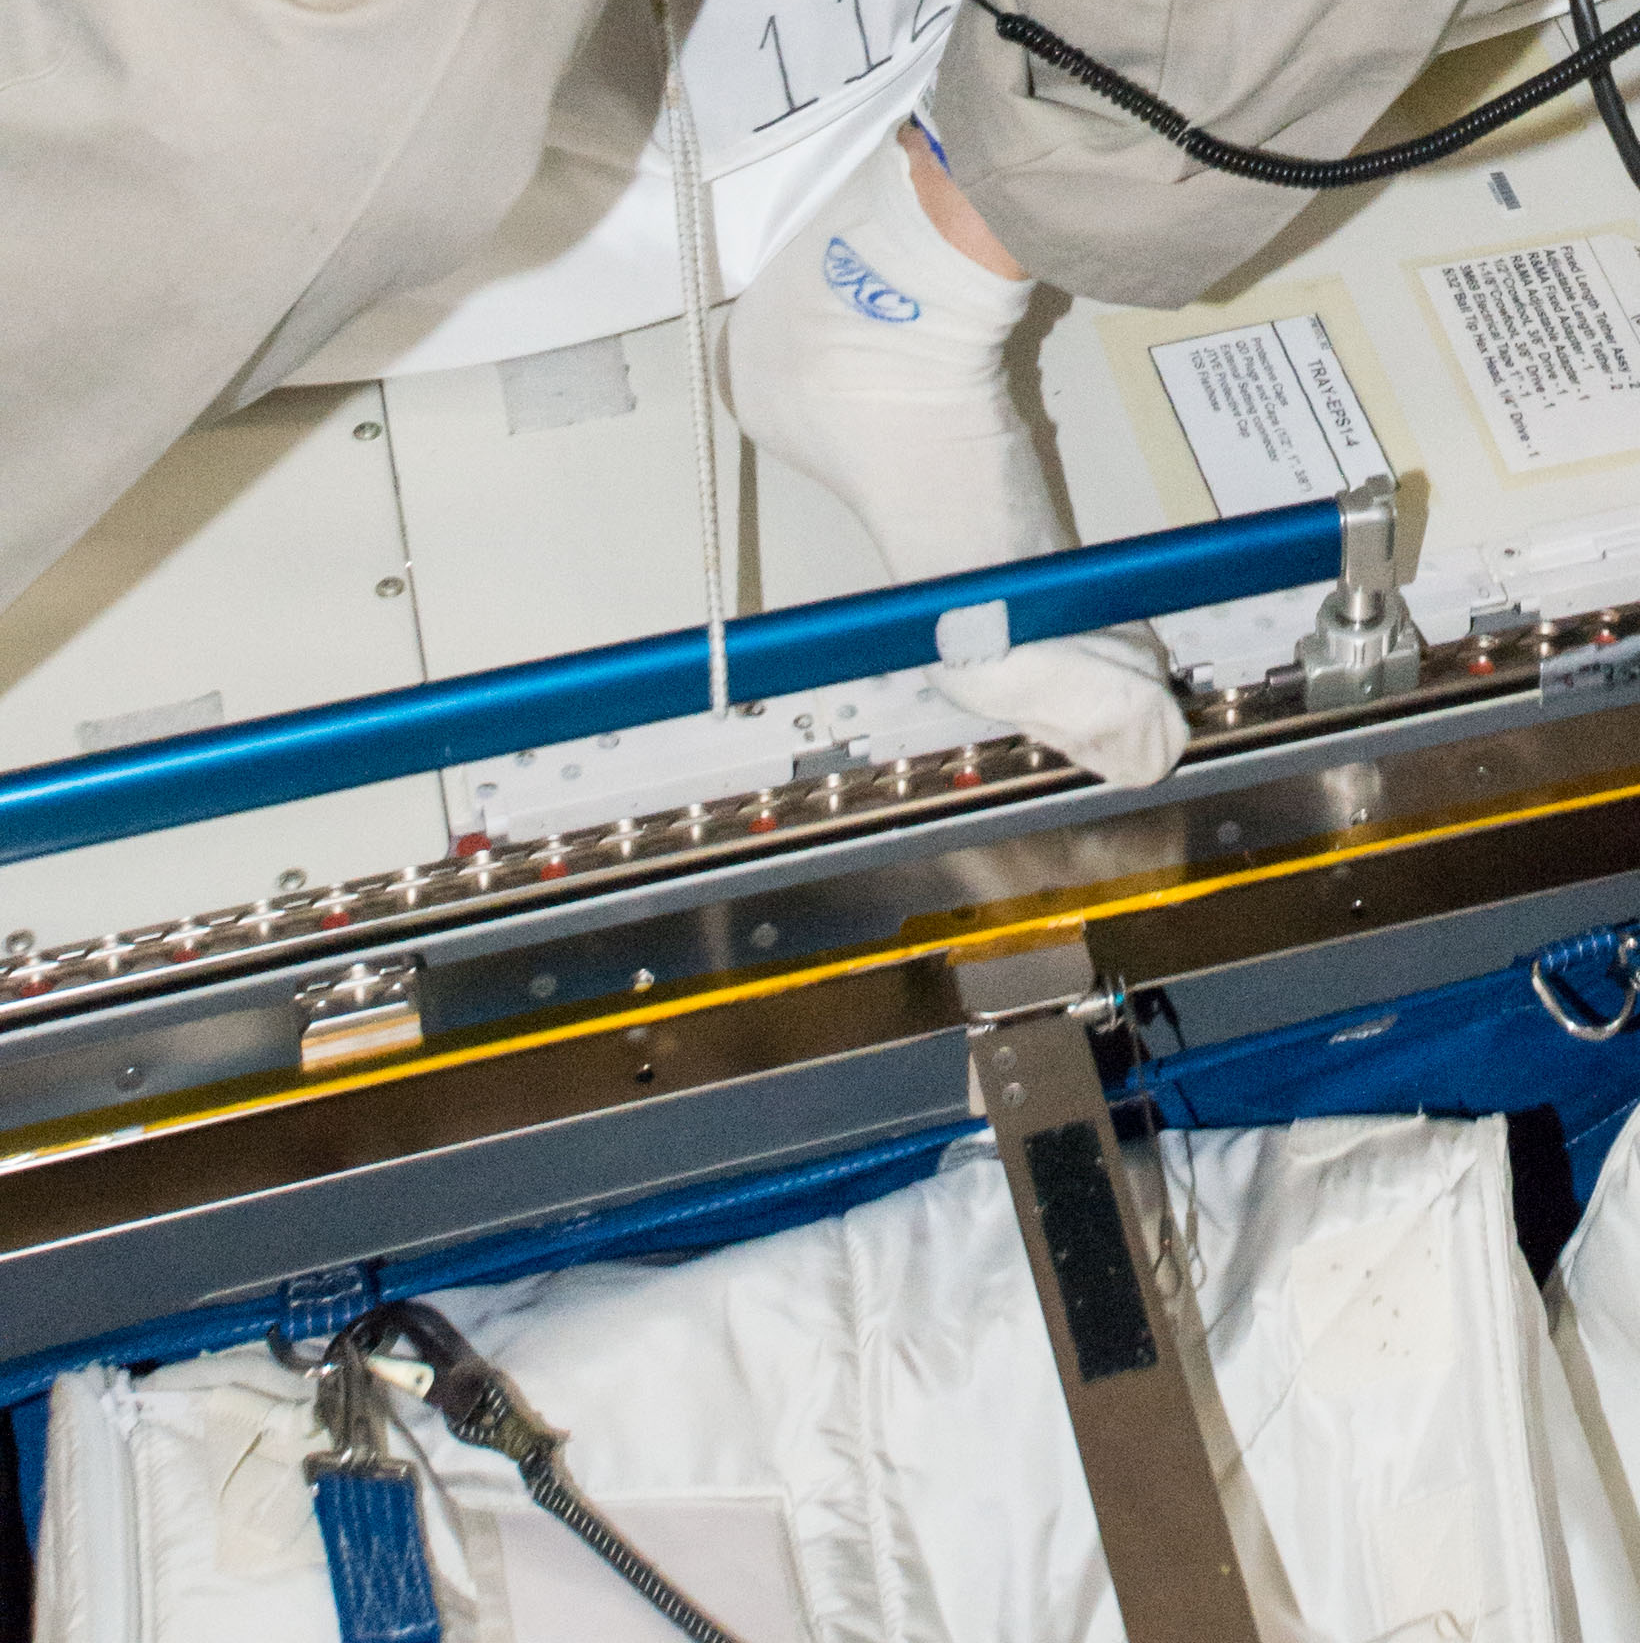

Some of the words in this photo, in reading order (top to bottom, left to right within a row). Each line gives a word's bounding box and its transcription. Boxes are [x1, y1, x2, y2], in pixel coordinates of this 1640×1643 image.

[1557, 244, 1583, 274] Fixed
[1540, 284, 1567, 314] Fixed
[1569, 273, 1602, 311] Length
[1460, 314, 1483, 333] Tip
[1538, 247, 1579, 302] Adjustable
[1565, 302, 1599, 341] Length
[1587, 341, 1615, 375] Tether
[1470, 292, 1506, 340] Electrical
[1492, 342, 1520, 370] Tape
[1470, 332, 1492, 354] Hex
[1520, 287, 1562, 343] Adjustable
[1549, 343, 1584, 387] Adapter
[1553, 314, 1588, 357] Adapter
[1592, 312, 1620, 345] Tether
[1185, 349, 1206, 370] TCS
[1237, 355, 1264, 383] Plugs
[1248, 337, 1281, 383] Protective
[1268, 382, 1292, 408] Caps
[1534, 350, 1561, 381] Drive
[1606, 345, 1634, 374] Assy
[1252, 383, 1271, 402] and
[1523, 364, 1549, 394] Drive
[1211, 371, 1246, 418] Protective
[1231, 418, 1254, 440] Cap
[1217, 343, 1245, 380] External
[1232, 381, 1261, 416] Setting
[1249, 415, 1282, 463] connector
[1259, 401, 1284, 427] Caps
[1304, 358, 1363, 448] TRAY-EPS1-4
[1507, 412, 1534, 442] Drive
